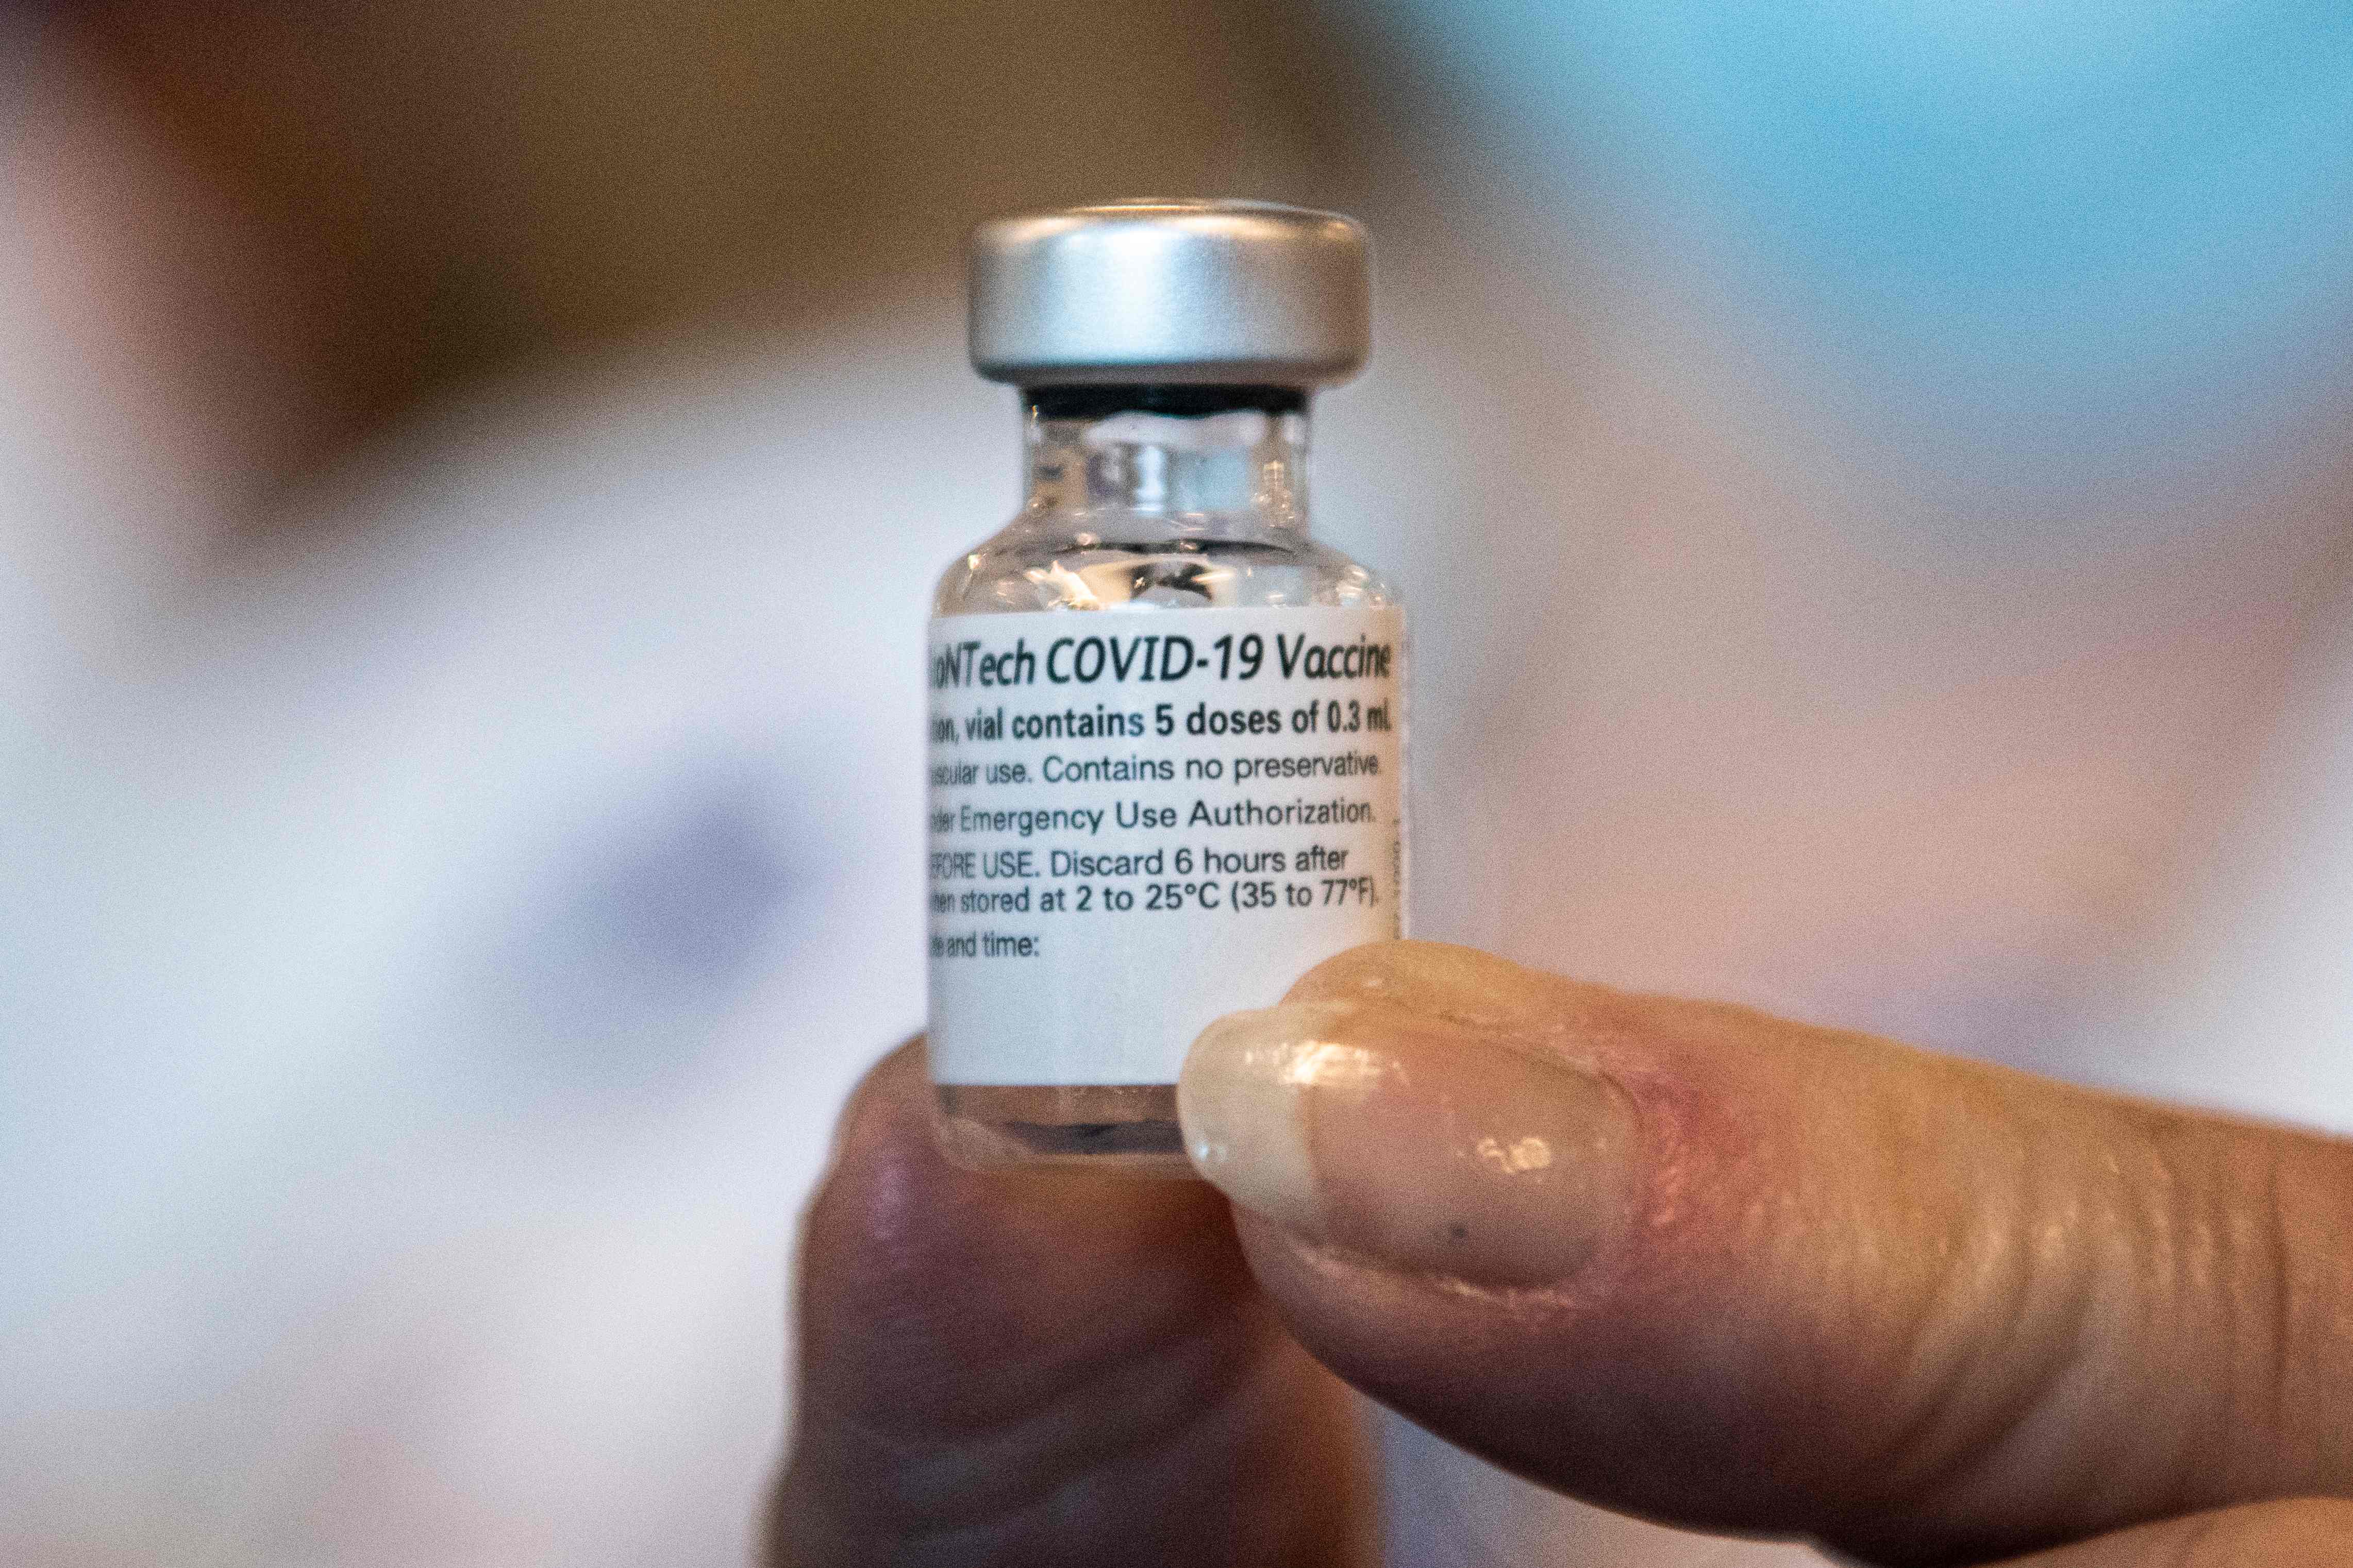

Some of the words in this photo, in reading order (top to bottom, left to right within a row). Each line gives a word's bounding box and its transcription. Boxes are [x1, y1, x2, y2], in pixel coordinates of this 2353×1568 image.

[1046, 634, 1264, 684] COVID-19
[1276, 634, 1390, 679] Vaccine
[966, 707, 1003, 740] vial
[1012, 704, 1145, 739] contains
[1156, 703, 1174, 736] 5
[1186, 702, 1281, 735] doses
[1291, 700, 1319, 734] of
[1327, 700, 1361, 733] 0.3
[986, 763, 1032, 784] use.
[1043, 755, 1175, 783] Contains
[1186, 758, 1224, 780] no
[960, 805, 1104, 837] Emergency
[1116, 802, 1177, 829] Use
[1188, 798, 1375, 827] Authorization.
[983, 850, 1040, 879] USE.
[1050, 848, 1163, 877] Discard
[1174, 848, 1193, 875] 6
[1204, 847, 1286, 874] hours
[1295, 845, 1348, 872] after
[960, 886, 1030, 913] stored
[1040, 888, 1065, 913] at
[1077, 885, 1092, 912] 2
[1103, 887, 1134, 911] to
[1146, 881, 1220, 911] 25°C
[1231, 881, 1276, 912] (35
[1285, 883, 1312, 907] to
[946, 932, 977, 958] and
[982, 932, 1039, 957] time:
